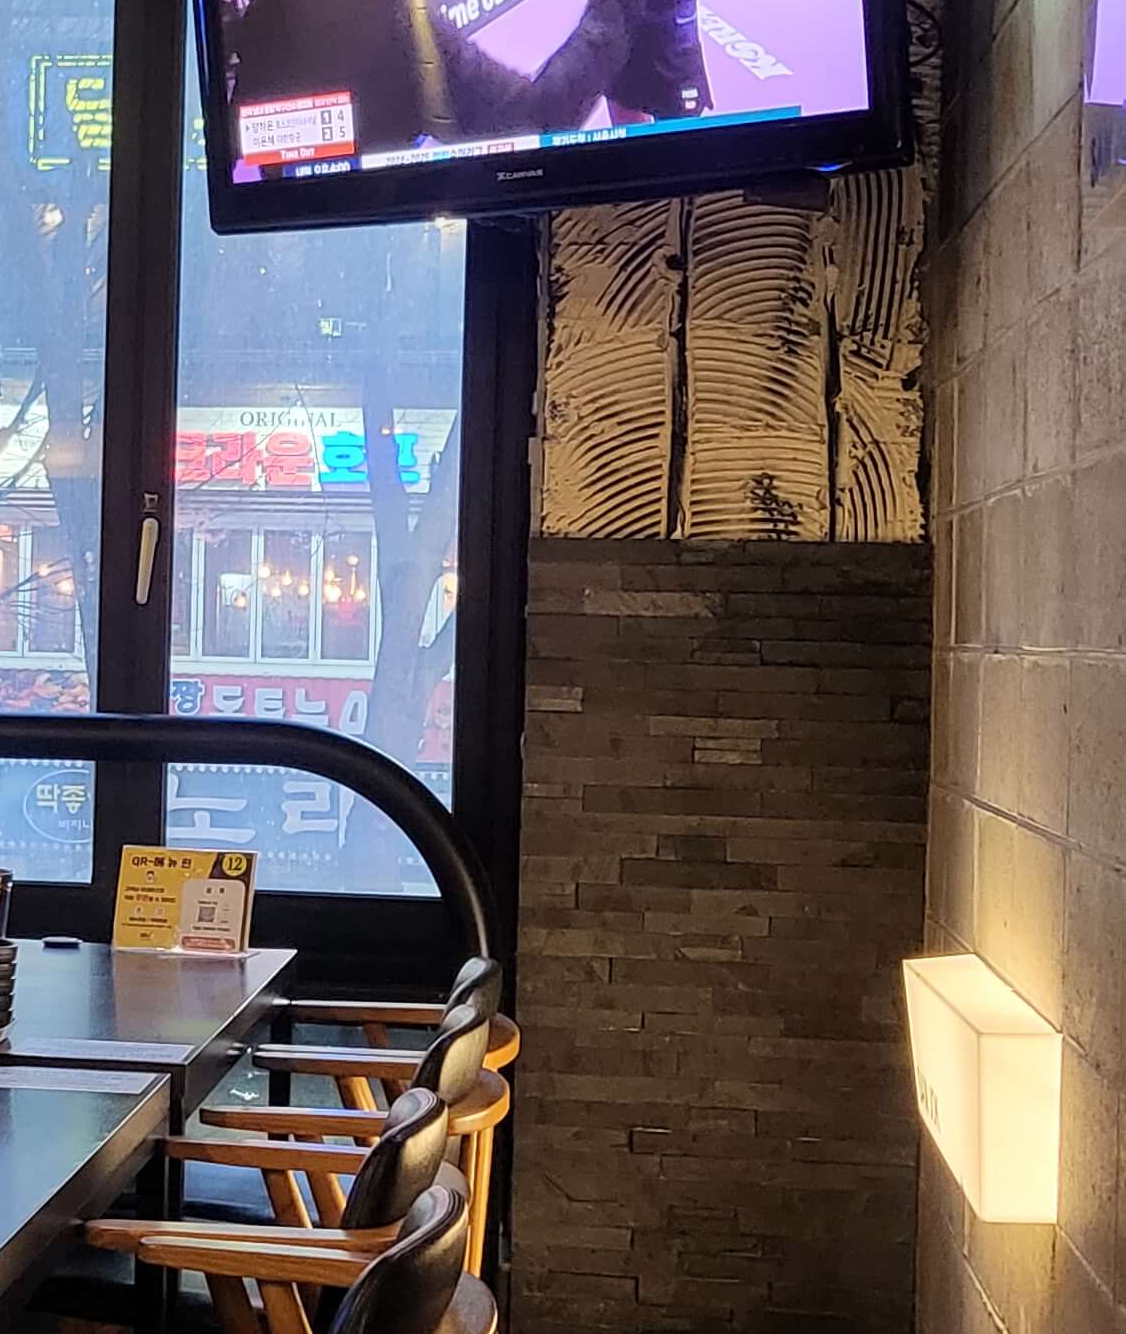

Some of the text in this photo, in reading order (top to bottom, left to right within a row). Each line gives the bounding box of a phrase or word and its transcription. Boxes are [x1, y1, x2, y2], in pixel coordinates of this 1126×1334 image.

[337, 109, 344, 121] 4
[339, 126, 346, 138] 5
[227, 857, 243, 871] 12
